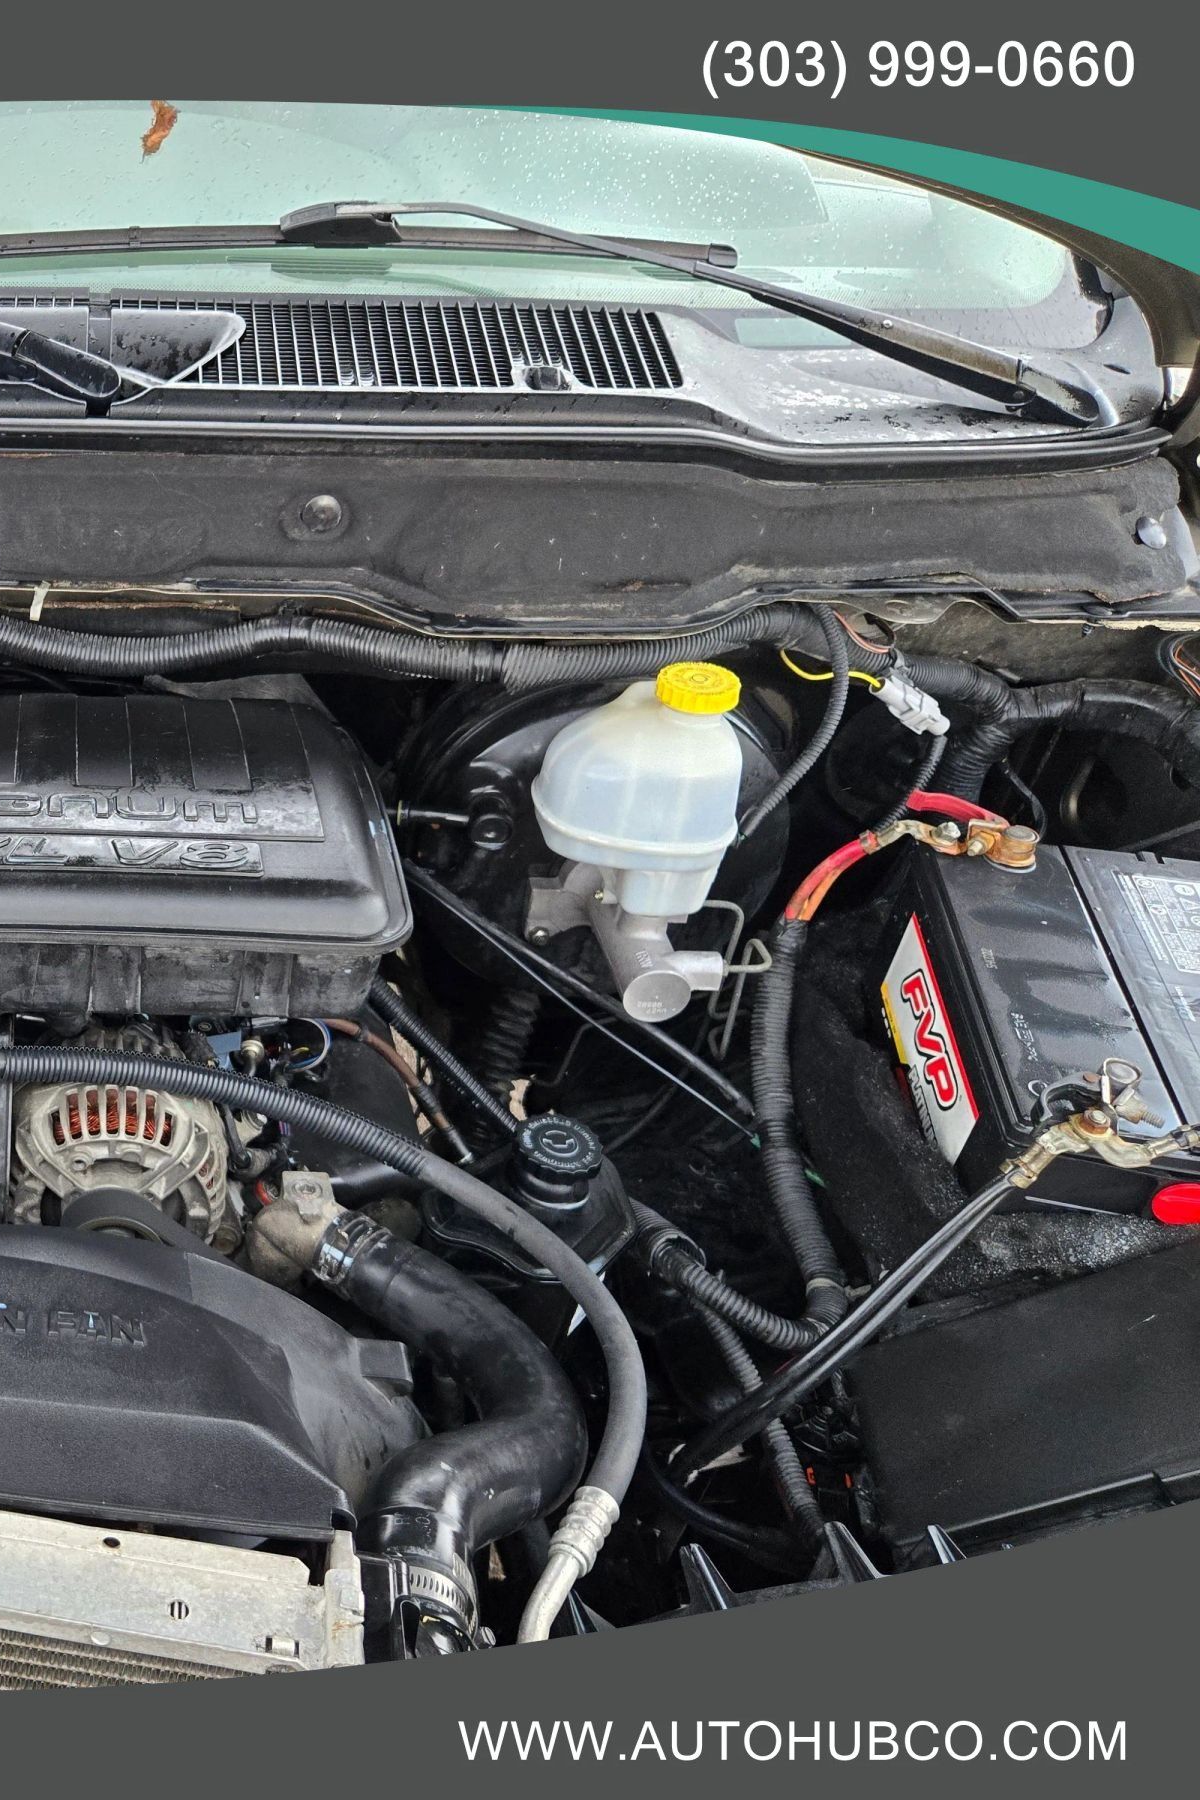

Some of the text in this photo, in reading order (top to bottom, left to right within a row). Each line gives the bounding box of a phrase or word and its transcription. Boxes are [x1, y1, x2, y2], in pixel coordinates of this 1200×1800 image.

[111, 839, 251, 869] V8
[901, 968, 959, 1112] FVP
[48, 1310, 146, 1347] FAN
